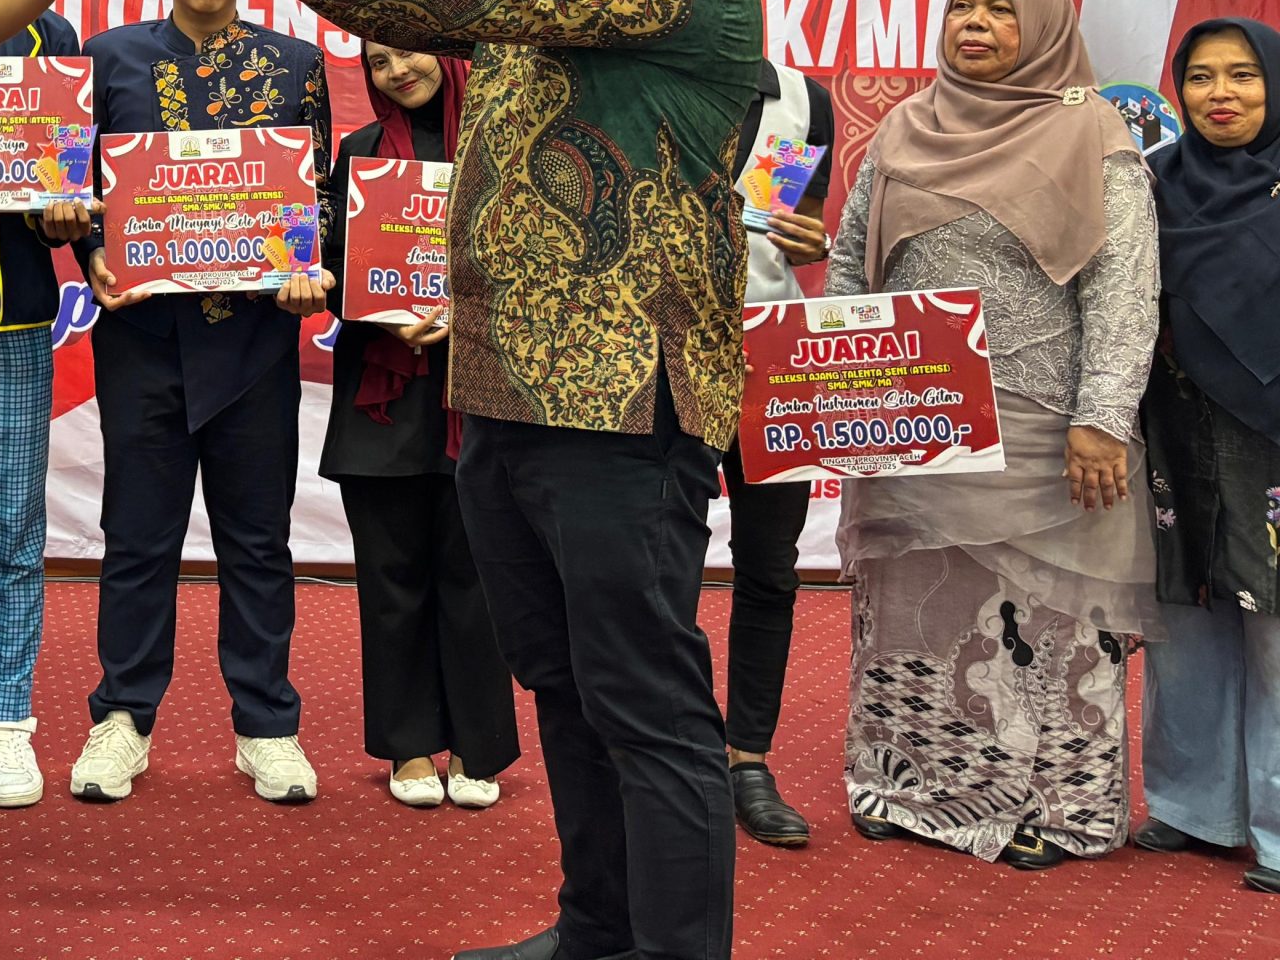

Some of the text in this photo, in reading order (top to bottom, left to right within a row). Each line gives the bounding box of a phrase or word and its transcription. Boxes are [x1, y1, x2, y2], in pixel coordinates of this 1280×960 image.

[28, 87, 40, 112] I
[149, 161, 265, 190] JUARA II
[134, 196, 166, 205] SELEKSI
[168, 195, 193, 203] AJANG
[195, 194, 228, 202] TALENTA
[251, 191, 284, 199] (ATENSI)
[125, 217, 164, 234] Lomba
[380, 224, 442, 235] SELEKSI AJANG
[127, 240, 164, 266] RP.
[203, 271, 236, 279] PROVINSI
[219, 278, 235, 286] 2025
[368, 267, 407, 296] RP.
[791, 330, 920, 367] JUARA I
[769, 364, 950, 384] SELEKSI AJANG TALENTA SENI (ATENSI)
[827, 379, 892, 390] SMA/SMK/MA
[766, 387, 962, 417] Lomba Instrumen Solo Gitar
[765, 414, 971, 452] RP. 1.500.000,-
[822, 453, 920, 465] TINGKAT PROVINSI ACEH
[847, 462, 897, 472] TAHUN 2025
